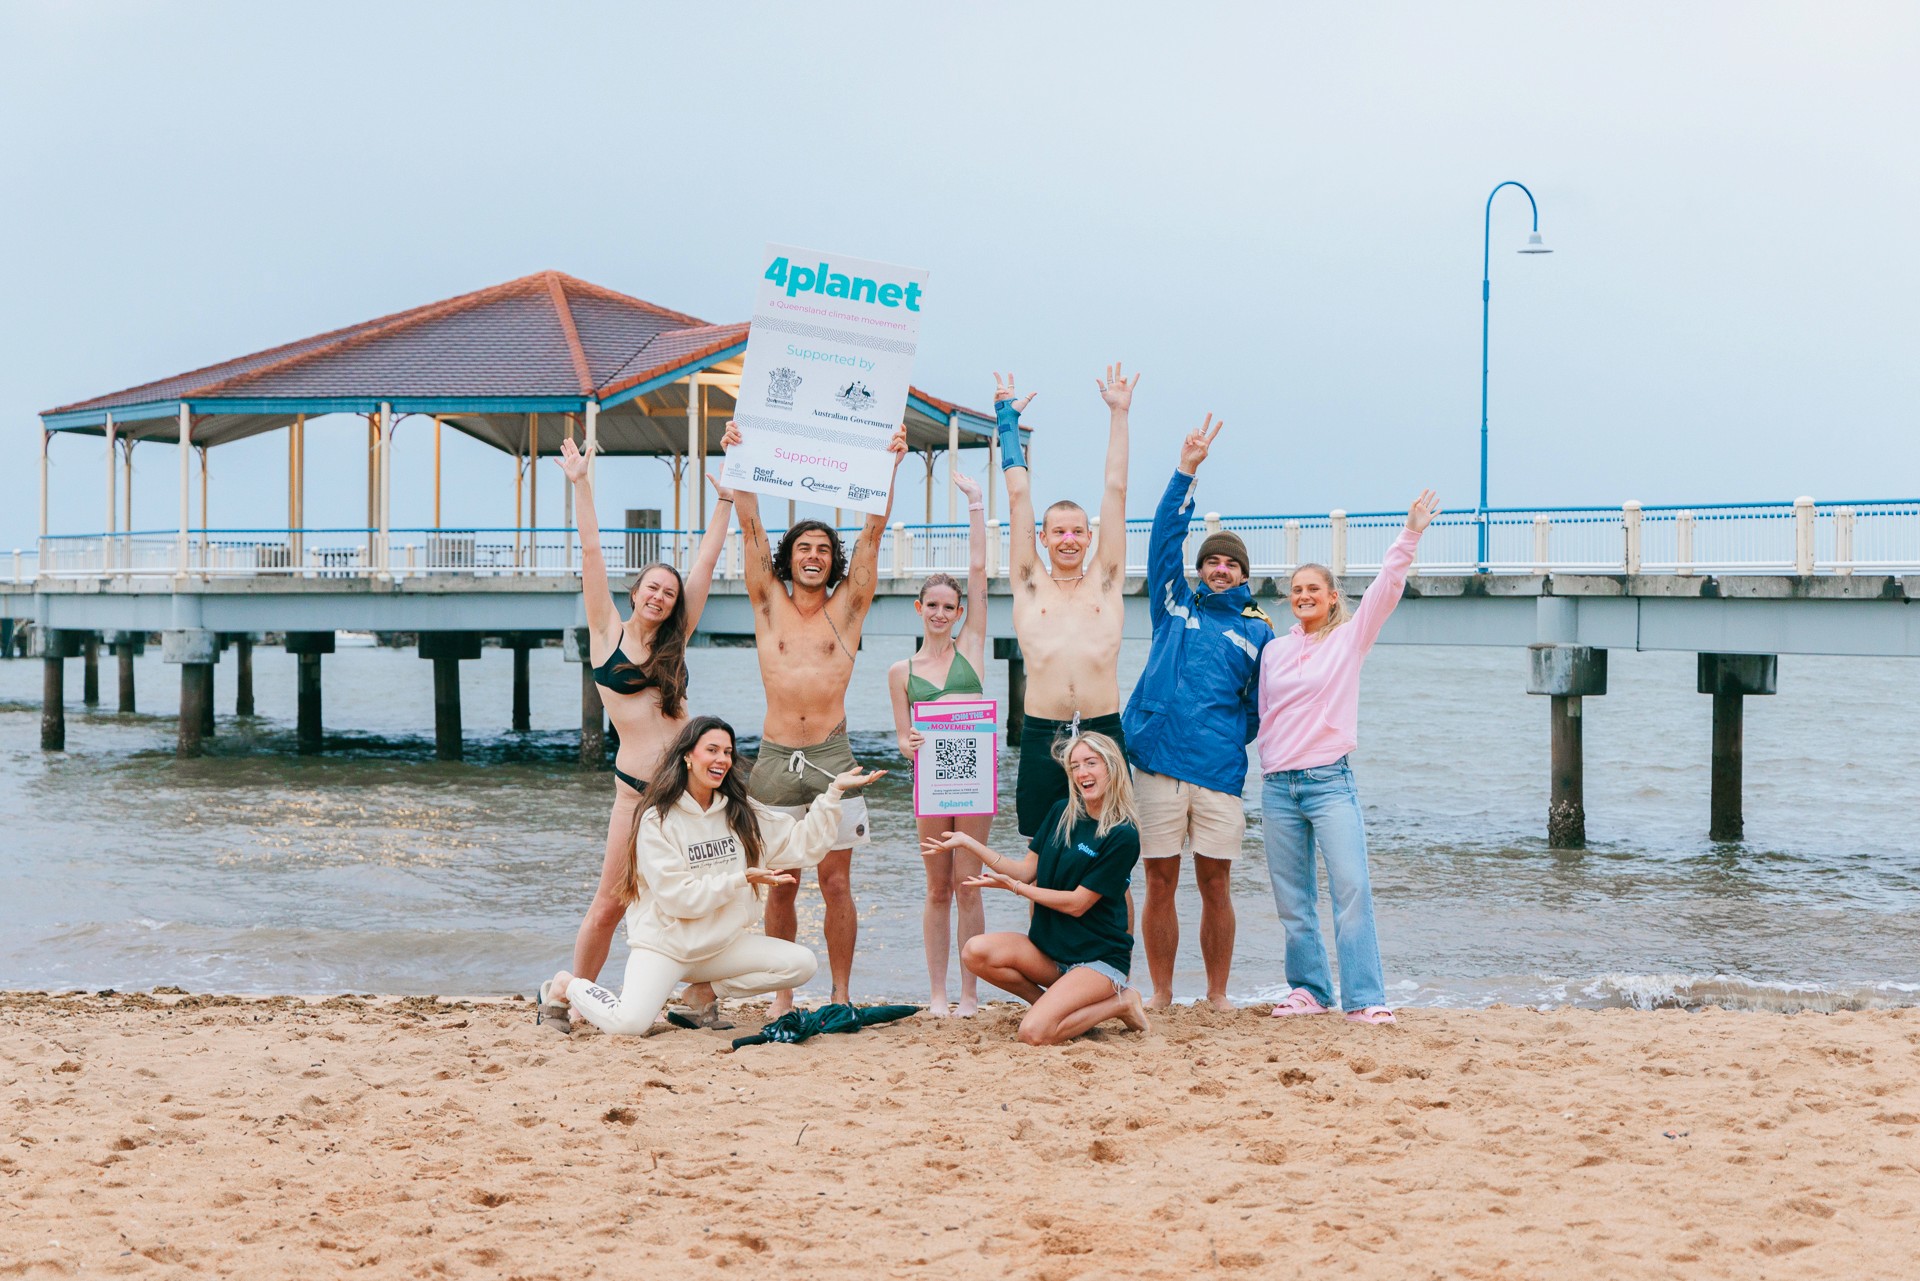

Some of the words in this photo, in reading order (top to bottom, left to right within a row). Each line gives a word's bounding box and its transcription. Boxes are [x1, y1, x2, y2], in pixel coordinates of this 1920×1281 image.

[764, 256, 922, 312] 4planet
[777, 300, 827, 316] Queensland
[828, 311, 860, 322] climate
[861, 316, 907, 331] movement
[786, 344, 856, 367] Supported
[859, 355, 876, 372] by
[812, 409, 848, 421] Australian
[849, 415, 893, 430] Government
[774, 447, 848, 473] Supporting
[752, 474, 794, 487] Unlimited
[754, 466, 775, 483] Reef
[847, 491, 870, 500] REEF
[849, 485, 887, 498] FOREVER
[951, 712, 969, 721] JOIN
[969, 711, 984, 719] THE
[930, 723, 976, 731] MOVEMENT
[938, 799, 974, 809] 4planet
[688, 838, 736, 861] COLDNIPS
